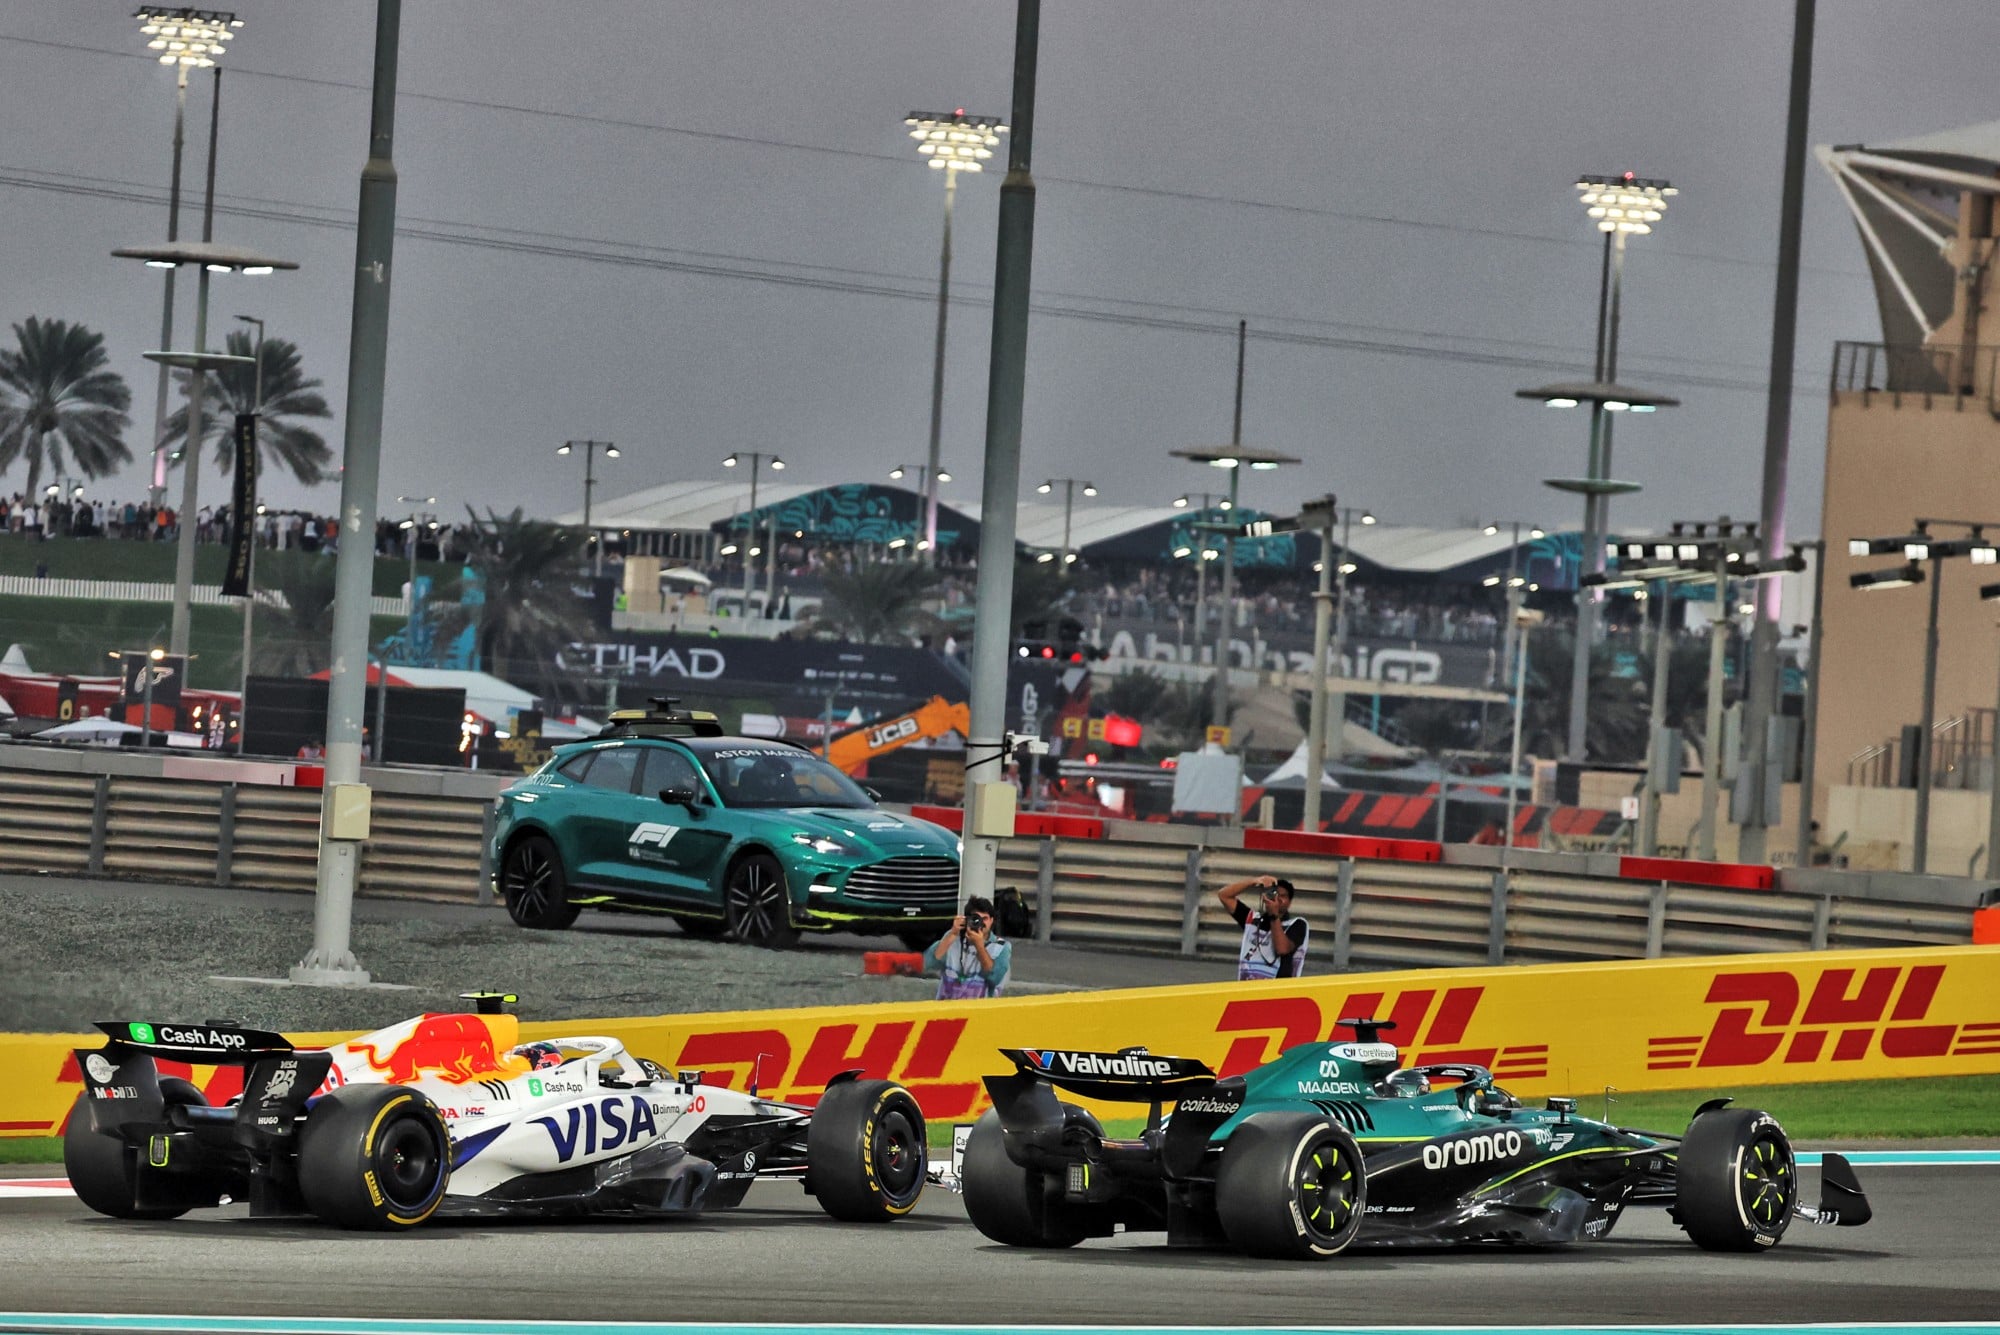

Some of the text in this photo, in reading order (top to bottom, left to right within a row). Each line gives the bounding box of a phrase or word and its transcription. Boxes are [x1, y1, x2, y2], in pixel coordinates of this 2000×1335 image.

[869, 717, 919, 749] JCB
[714, 750, 761, 760] ASTON
[628, 822, 681, 848] F1
[1695, 964, 1959, 1069] DHL
[161, 1027, 206, 1044] Cash
[209, 1030, 246, 1048] App
[1214, 986, 1499, 1085] DHL
[1358, 1048, 1395, 1058] CoreWeave
[280, 1061, 298, 1069] VISA
[675, 1018, 981, 1119] DHL
[1058, 1052, 1172, 1077] Valvoline
[94, 1087, 126, 1099] Mobil
[545, 1082, 565, 1093] Cash
[566, 1083, 583, 1094] App
[1298, 1081, 1360, 1094] MAADEN
[465, 1107, 485, 1116] HRC
[1180, 1097, 1240, 1114] coinbase
[258, 1116, 279, 1125] HUGO
[527, 1096, 657, 1164] VISA
[864, 1119, 880, 1192] P ZERO
[1422, 1130, 1522, 1170] aramco
